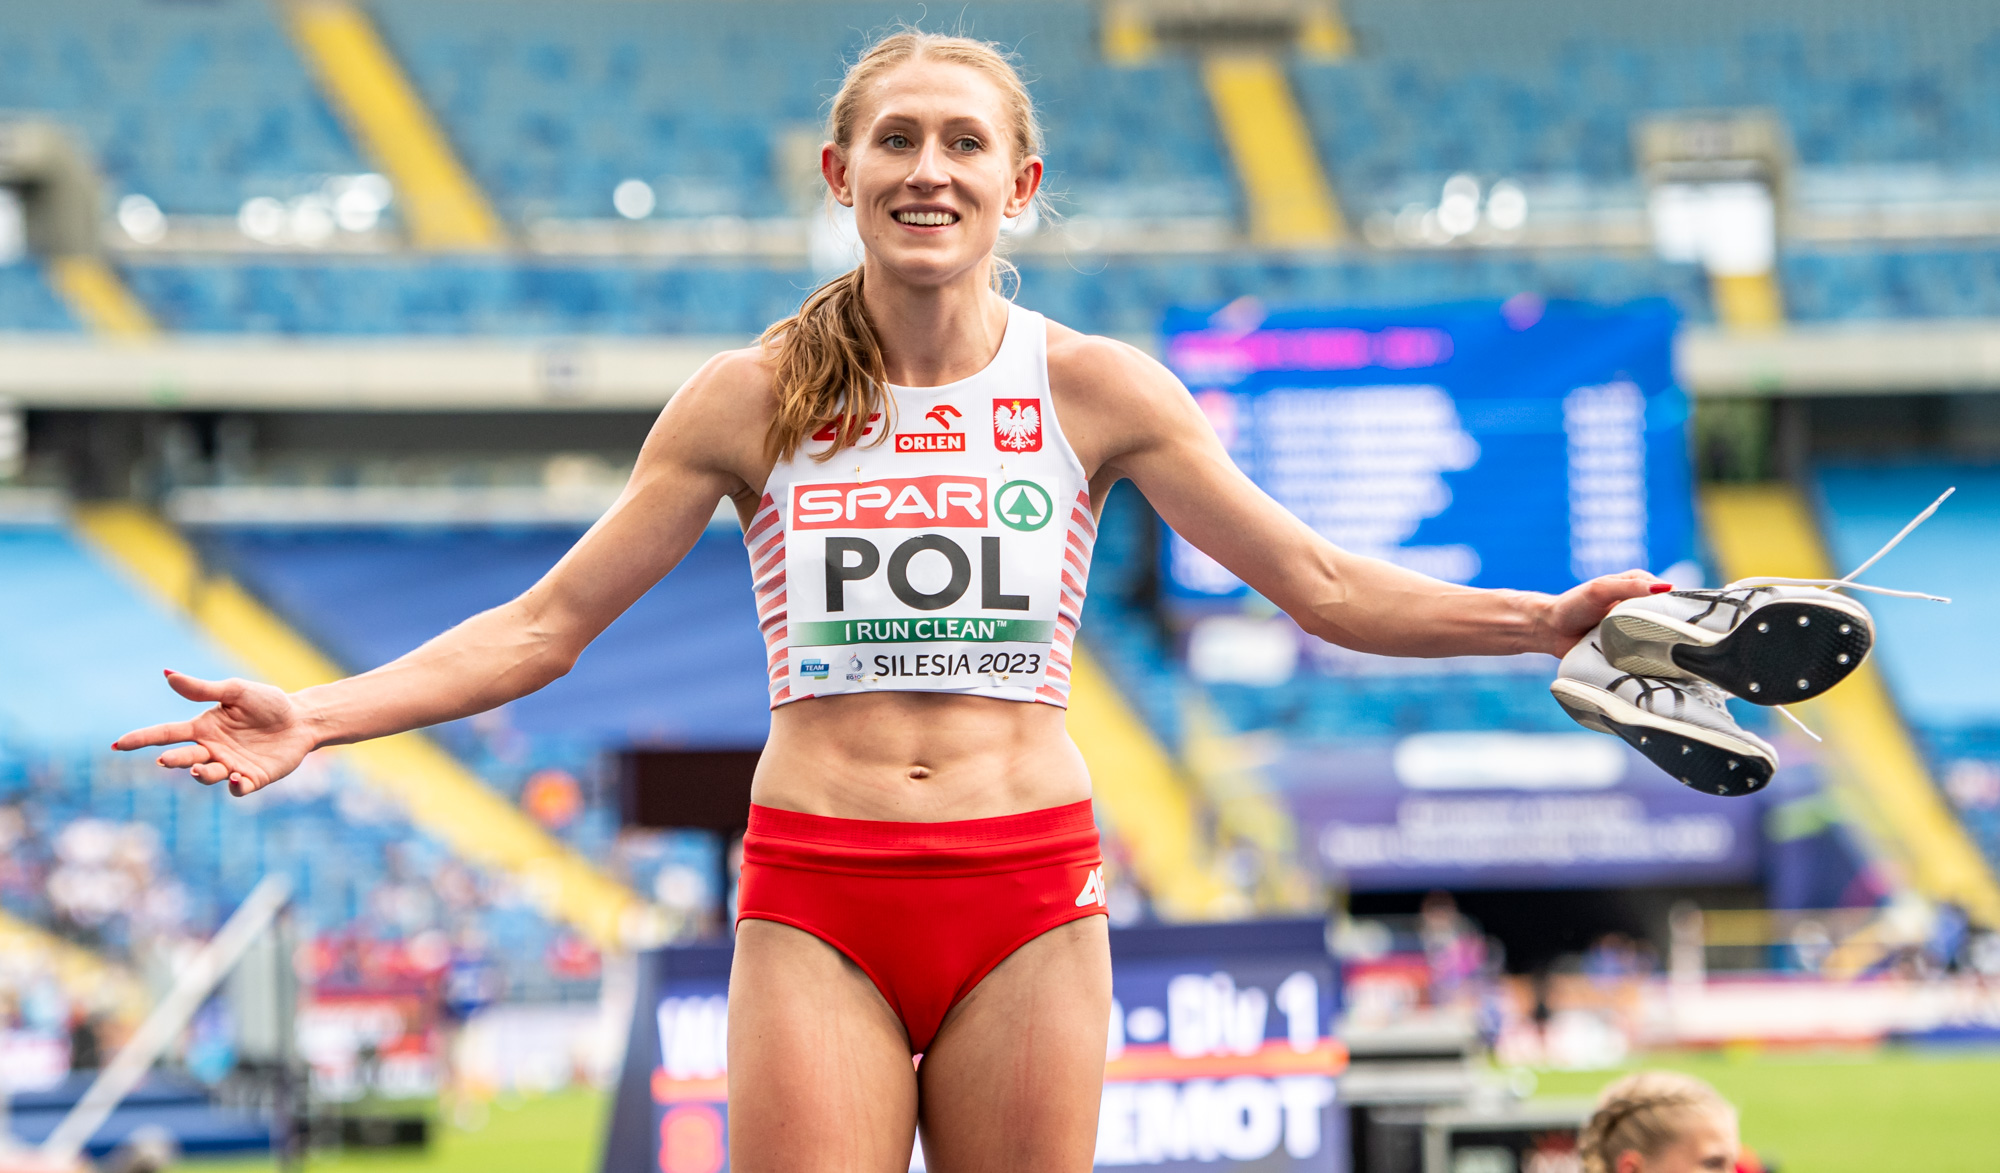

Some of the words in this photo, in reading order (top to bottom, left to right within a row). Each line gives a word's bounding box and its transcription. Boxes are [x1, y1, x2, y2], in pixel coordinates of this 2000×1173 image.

[898, 435, 961, 451] ORLEN
[798, 482, 983, 523] SPAR
[825, 534, 1030, 613] POL
[845, 623, 851, 642] I
[857, 620, 909, 640] RUN
[874, 653, 971, 677] SILESIA
[978, 652, 1041, 674] 2023
